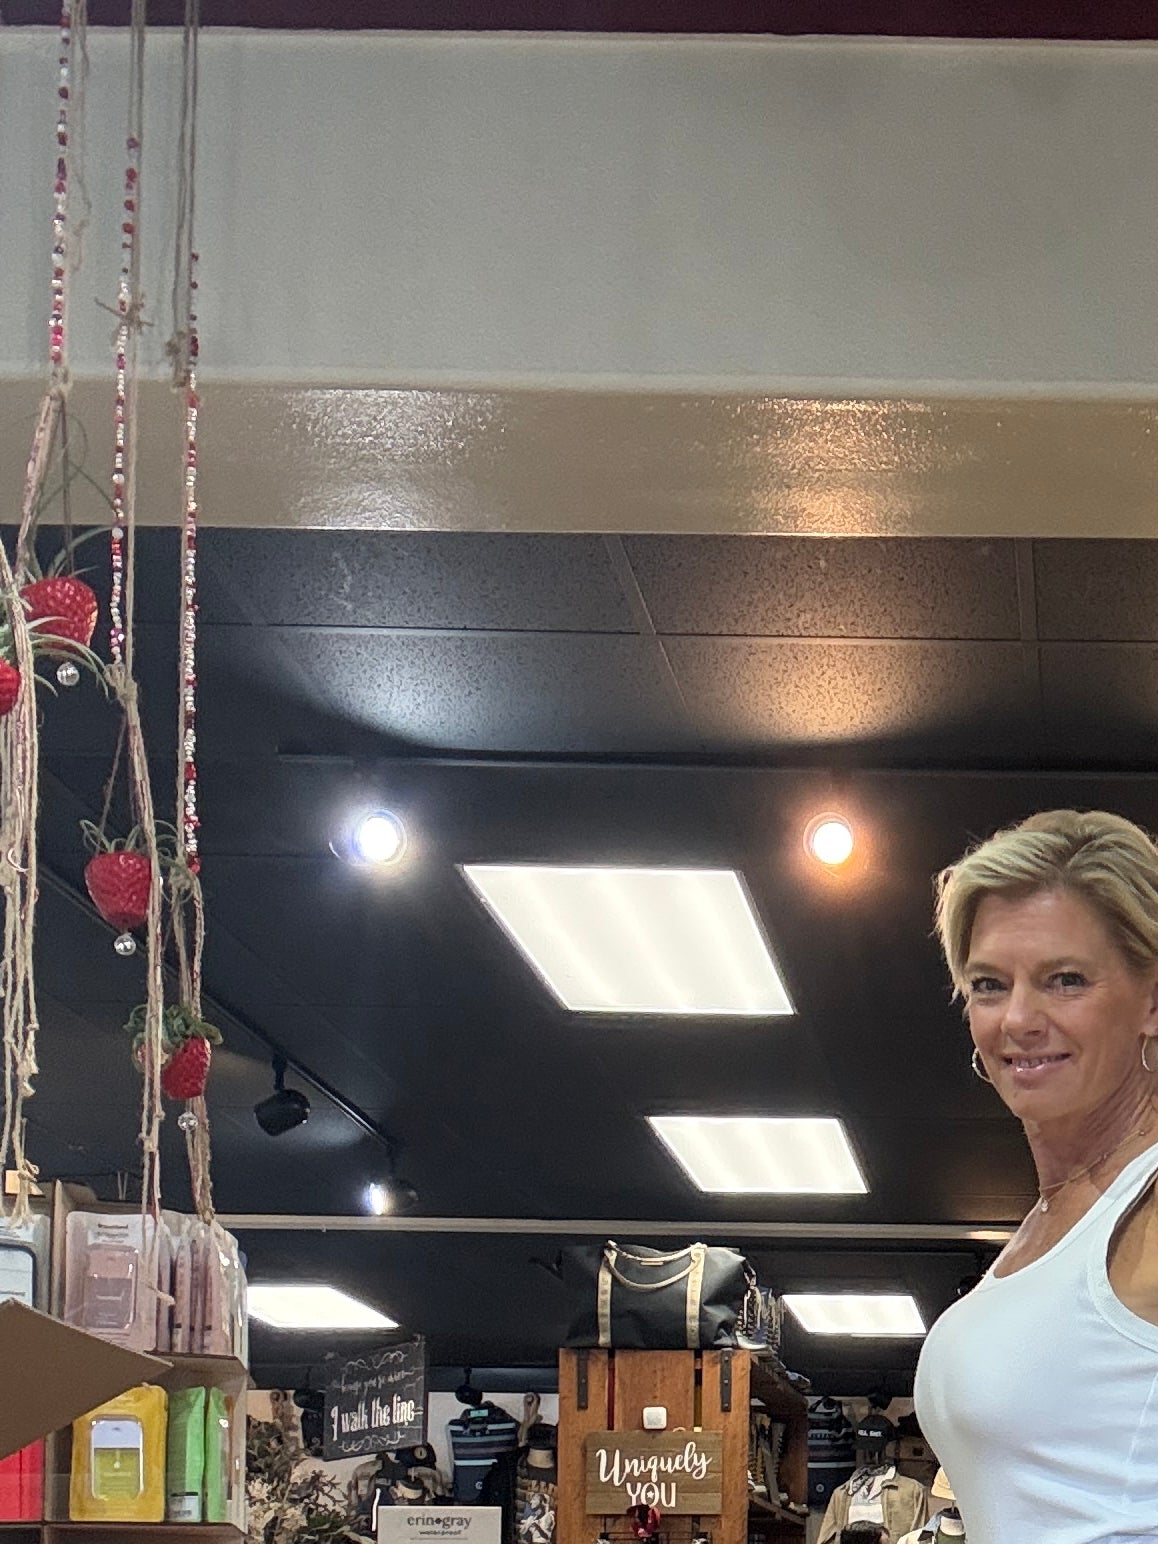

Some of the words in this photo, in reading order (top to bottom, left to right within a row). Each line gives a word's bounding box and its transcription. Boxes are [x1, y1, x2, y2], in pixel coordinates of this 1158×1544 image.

[330, 1405, 339, 1441] I
[341, 1401, 369, 1433] walk
[371, 1396, 391, 1428] the
[392, 1393, 416, 1426] line
[595, 1441, 713, 1487] Uniquely
[625, 1482, 677, 1508] YOU
